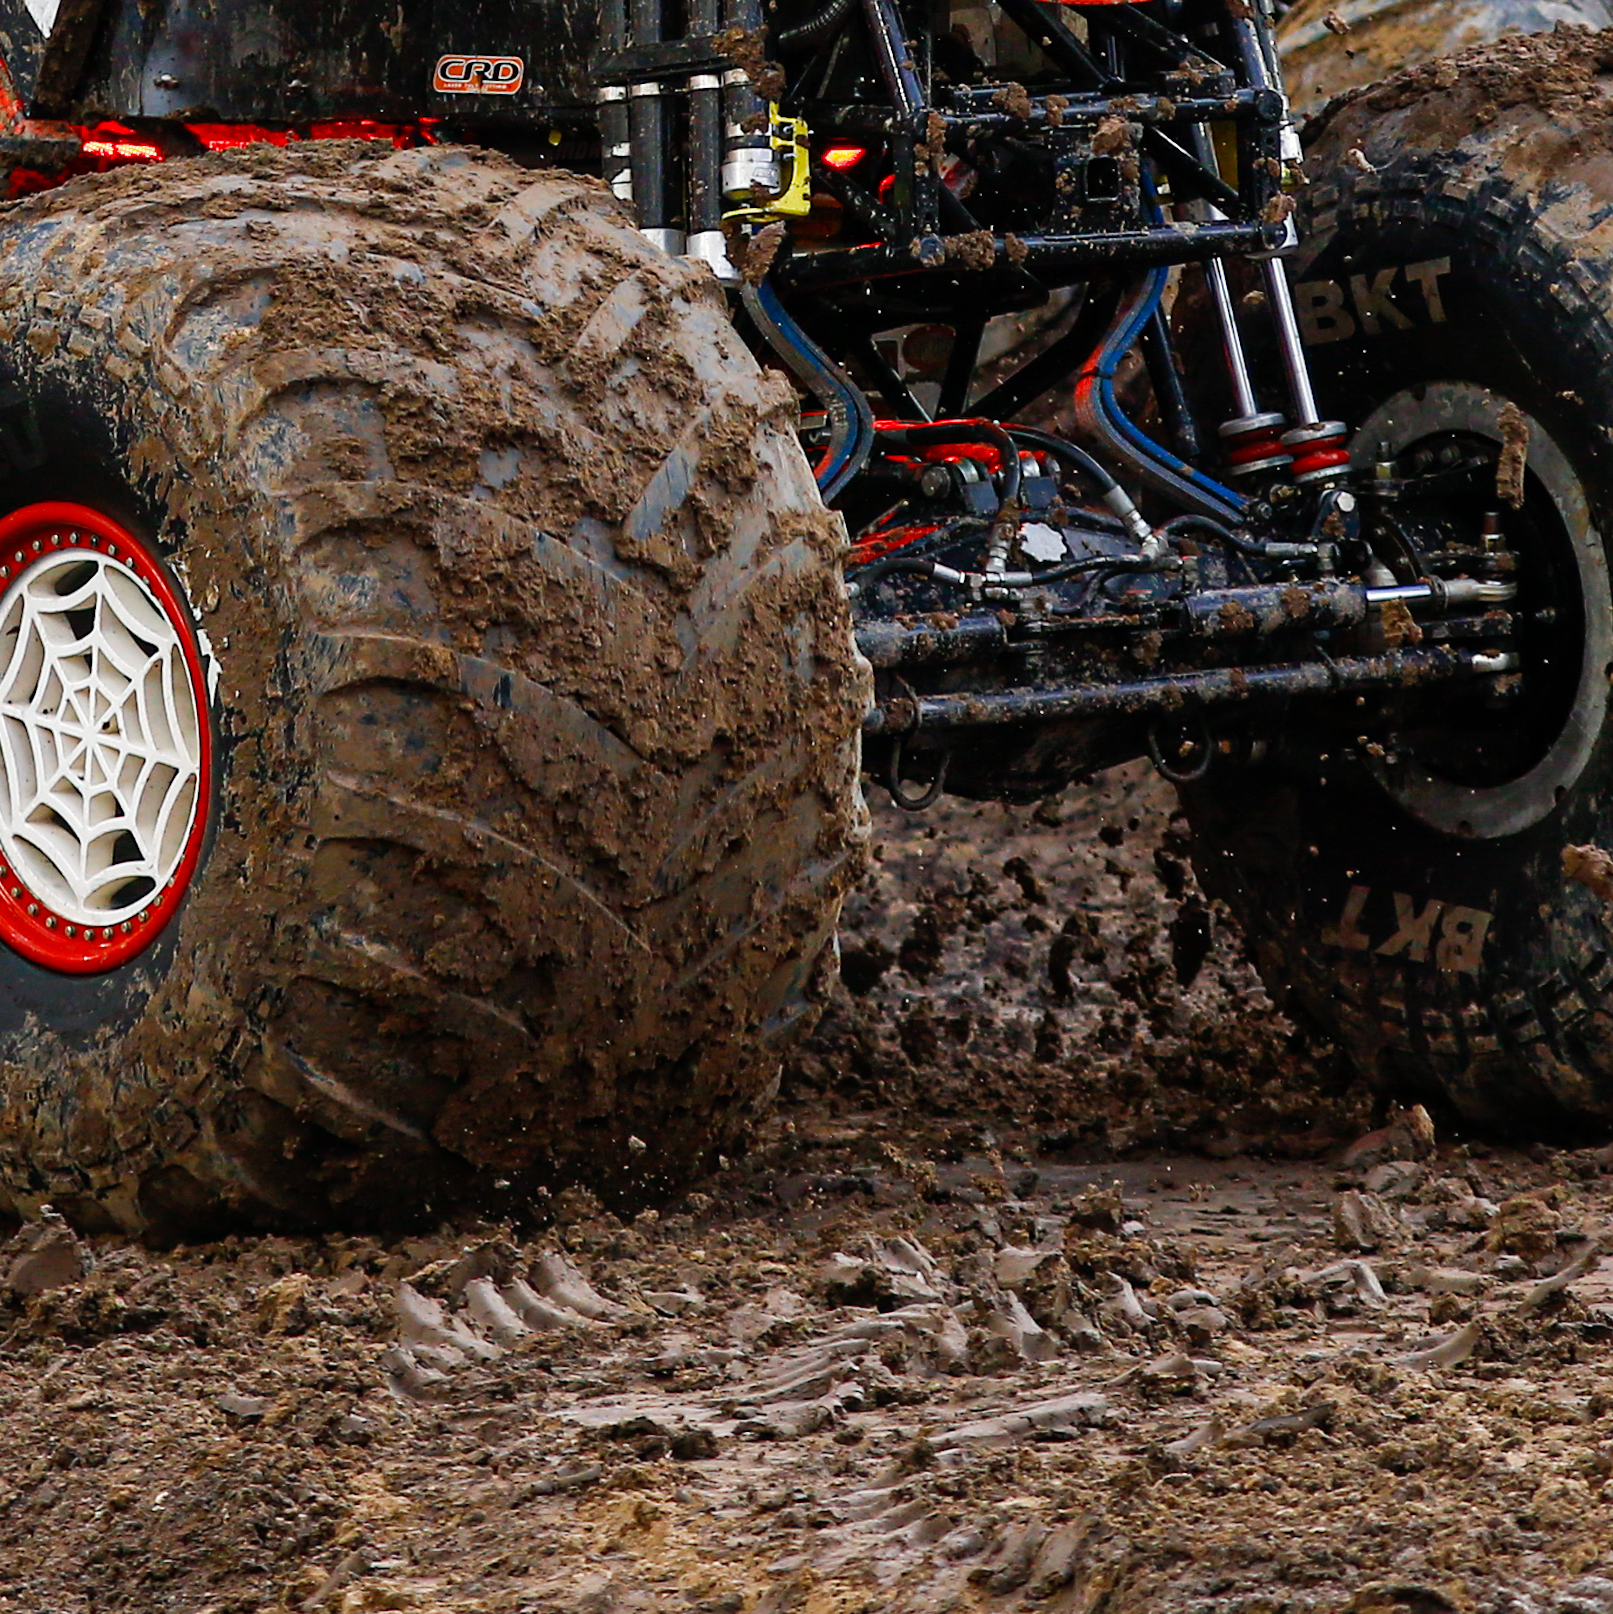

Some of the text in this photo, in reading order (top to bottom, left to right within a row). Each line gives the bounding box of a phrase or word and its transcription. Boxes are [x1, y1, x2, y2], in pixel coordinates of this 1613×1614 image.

[437, 59, 521, 83] CRD
[1294, 255, 1452, 347] BKT
[1321, 885, 1495, 977] BKT
